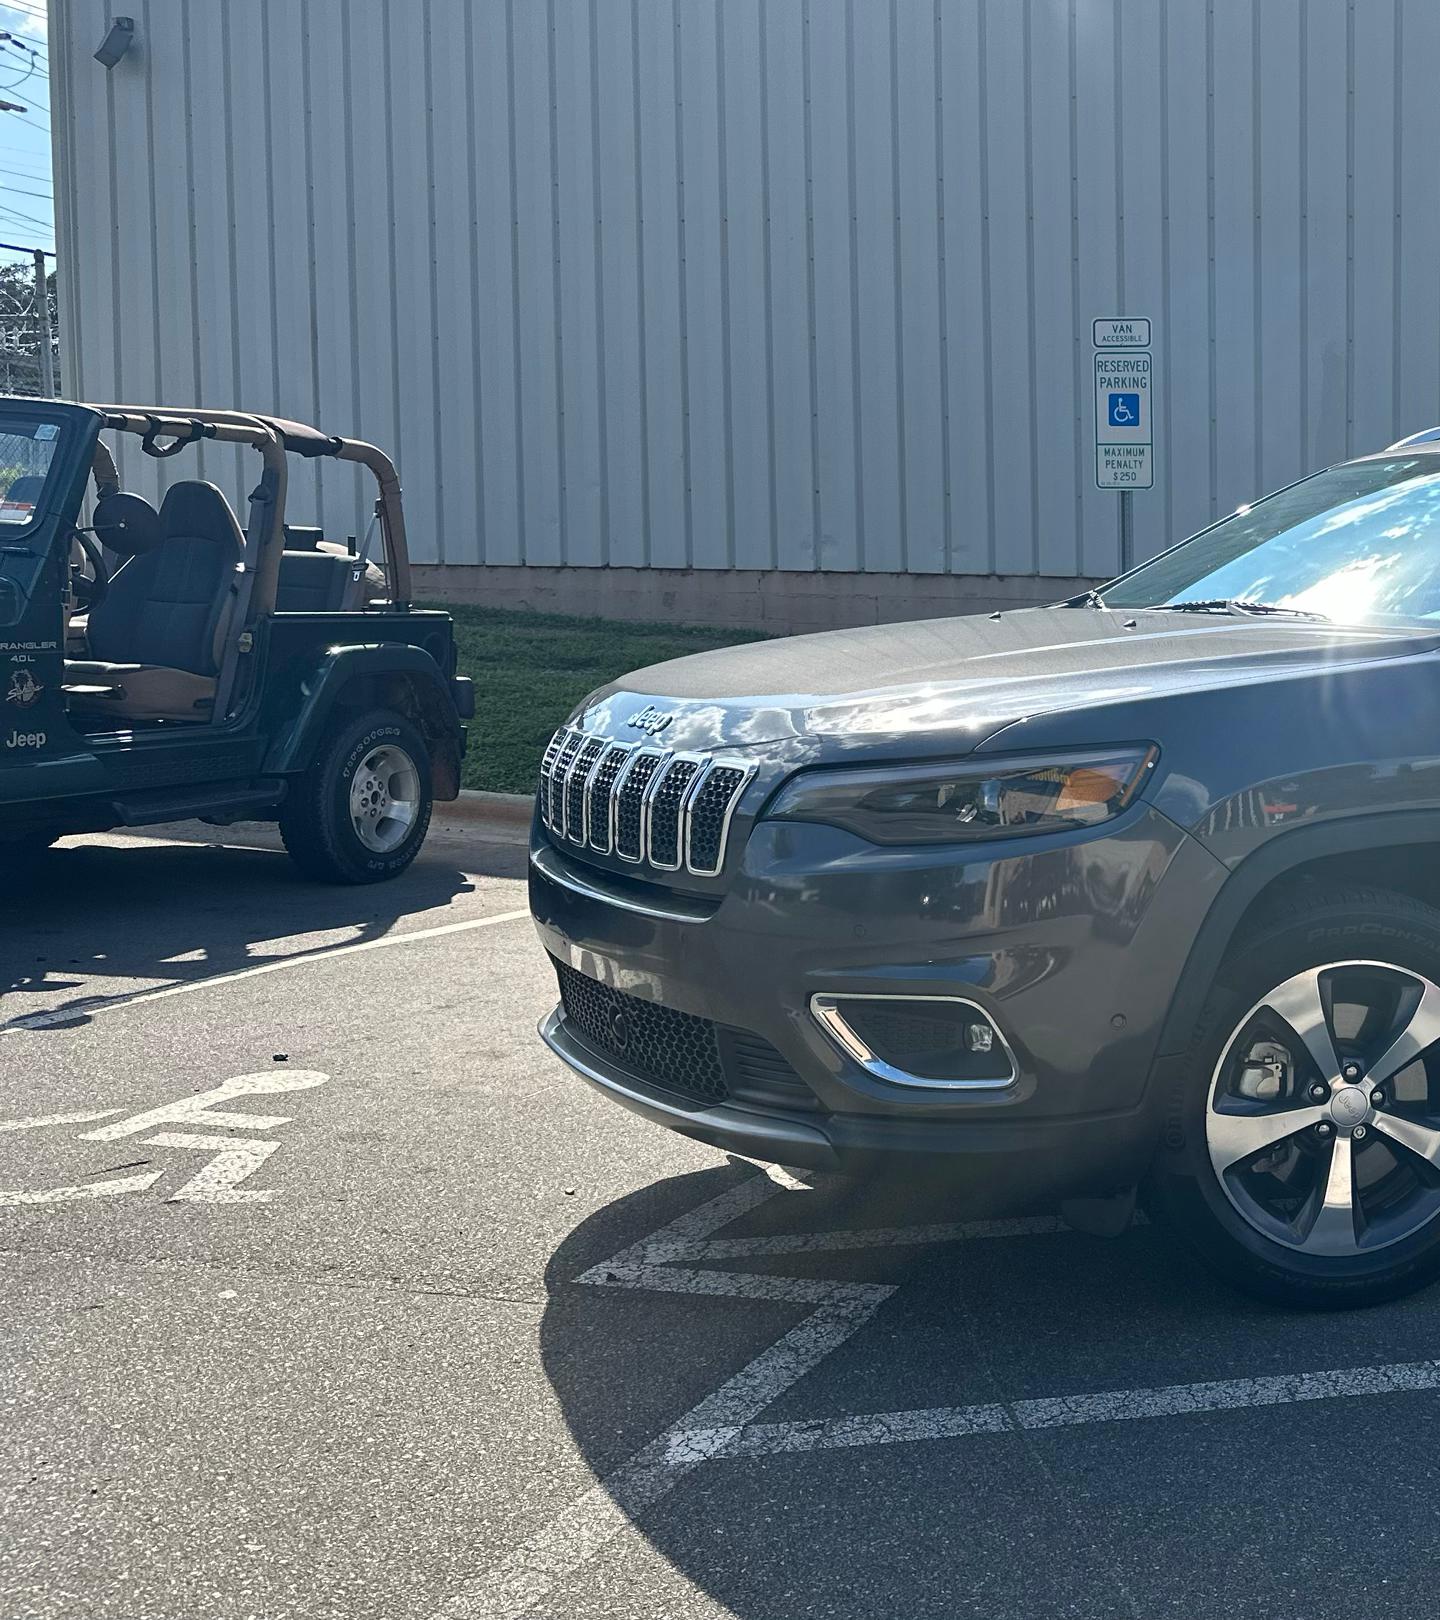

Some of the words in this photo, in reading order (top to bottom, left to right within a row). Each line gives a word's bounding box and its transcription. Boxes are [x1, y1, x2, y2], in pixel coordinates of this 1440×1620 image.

[1112, 324, 1133, 333] VAN
[1097, 360, 1149, 373] RESERVED
[1100, 376, 1147, 389] PARKING
[1104, 448, 1145, 457] MAXIMUM
[1105, 460, 1144, 469] PENALTY
[1113, 472, 1137, 482] $250
[0, 641, 57, 650] RANGLER
[627, 704, 673, 737] Jeep
[6, 730, 47, 749] Jeep
